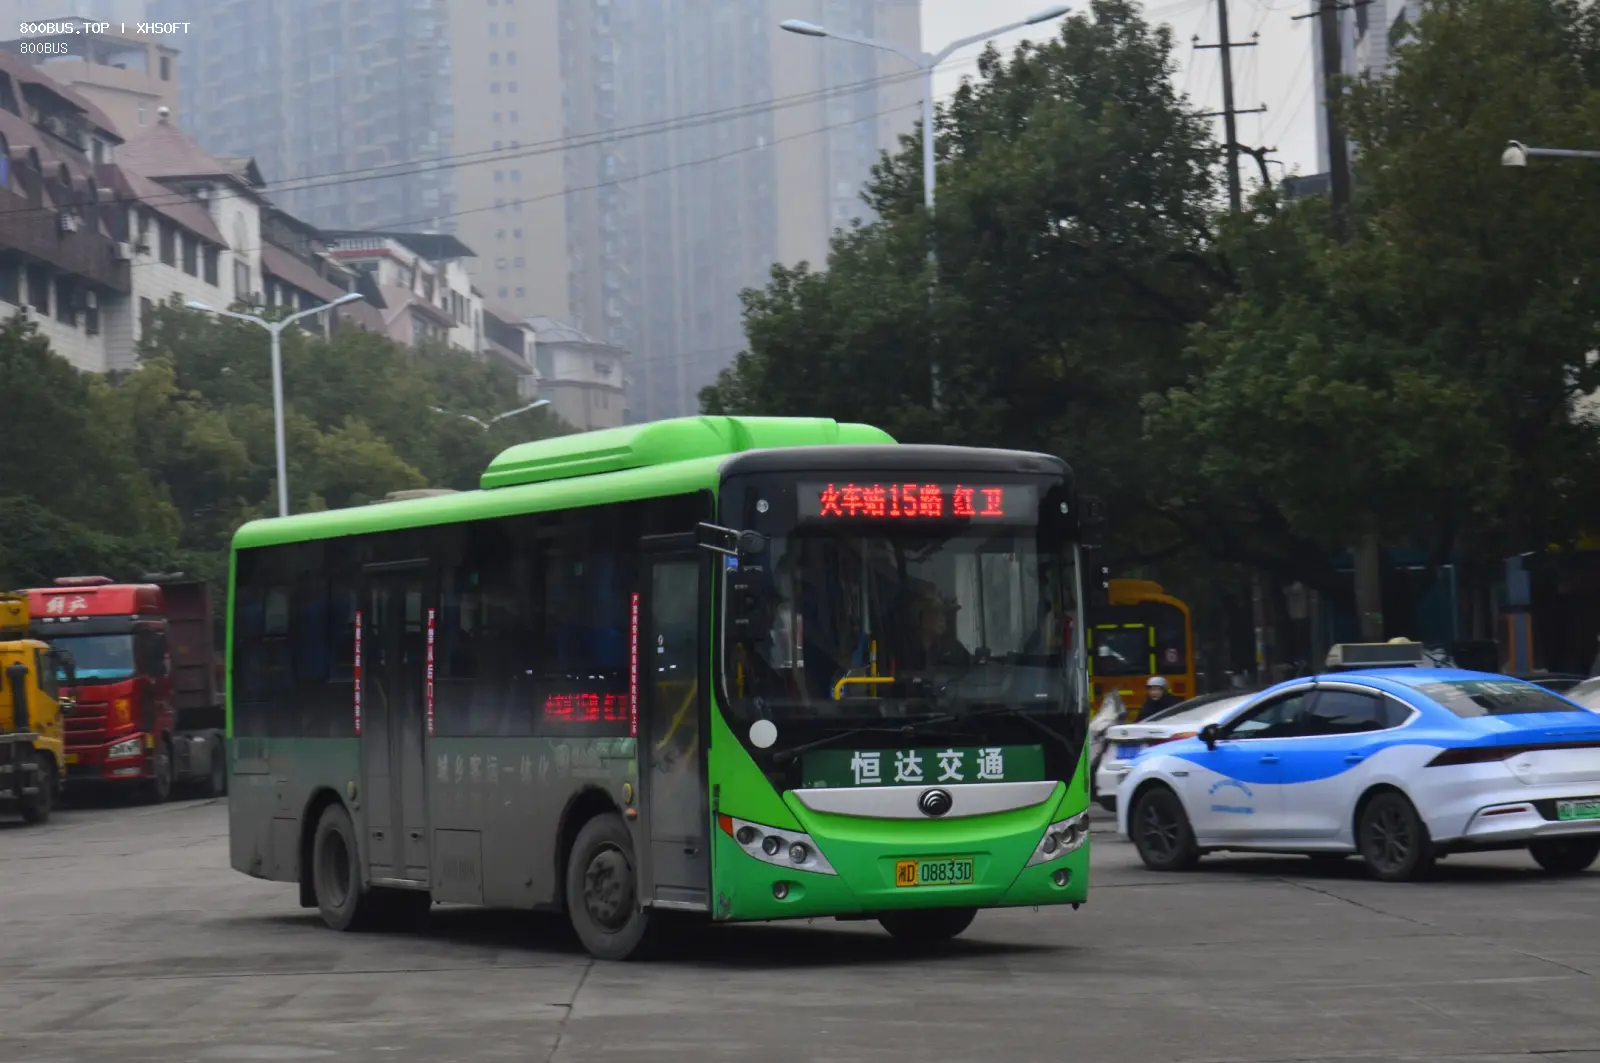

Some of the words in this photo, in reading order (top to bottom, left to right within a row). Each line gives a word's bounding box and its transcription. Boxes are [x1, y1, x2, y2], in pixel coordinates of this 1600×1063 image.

[820, 483, 943, 517] 火车站15路
[953, 484, 1004, 517] 红卫
[851, 747, 1005, 785] 恒达交通
[921, 862, 972, 882] 08833D
